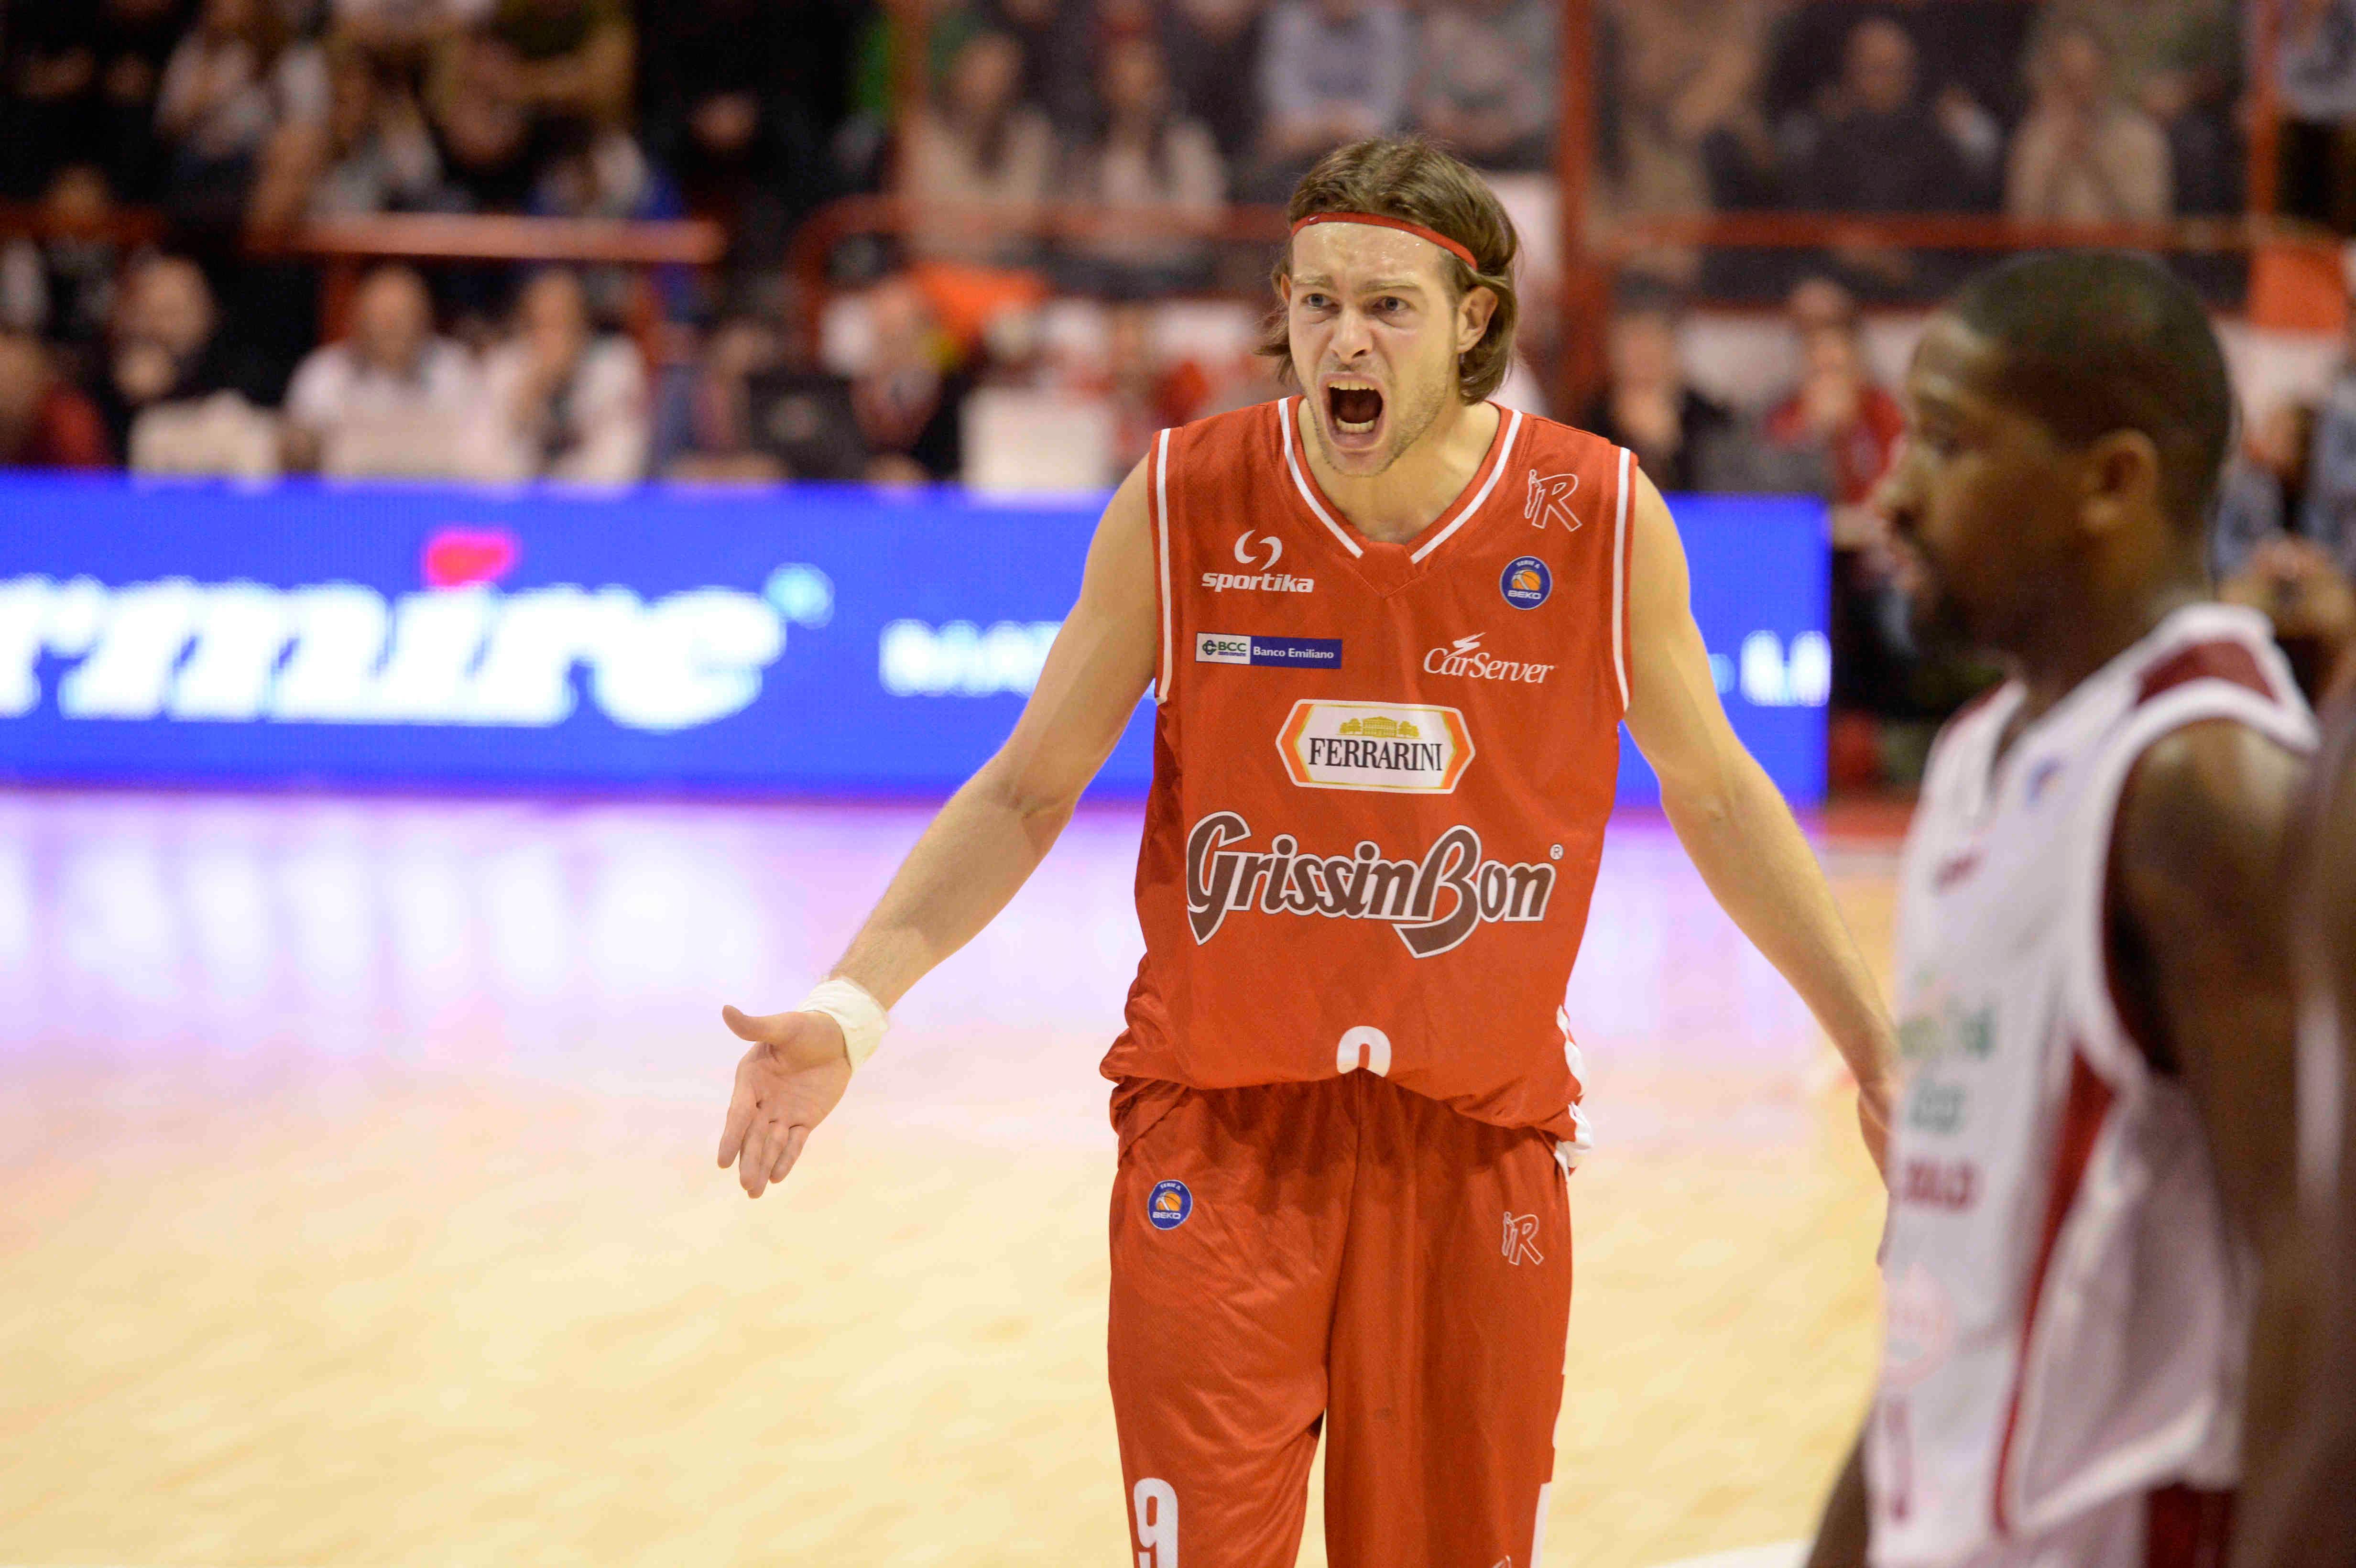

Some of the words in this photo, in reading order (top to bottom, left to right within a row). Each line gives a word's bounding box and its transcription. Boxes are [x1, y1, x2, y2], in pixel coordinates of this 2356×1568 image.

[1201, 573, 1314, 593] sportika
[1508, 590, 1541, 599] BEKO
[1218, 641, 1247, 652] BCC
[1253, 646, 1286, 657] Banco
[1288, 648, 1334, 659] Emiliano
[1423, 647, 1555, 684] CarServer
[1308, 737, 1442, 771] FERRARINI
[1153, 1211, 1181, 1220] BEKO
[1133, 1477, 1178, 1568] 9
